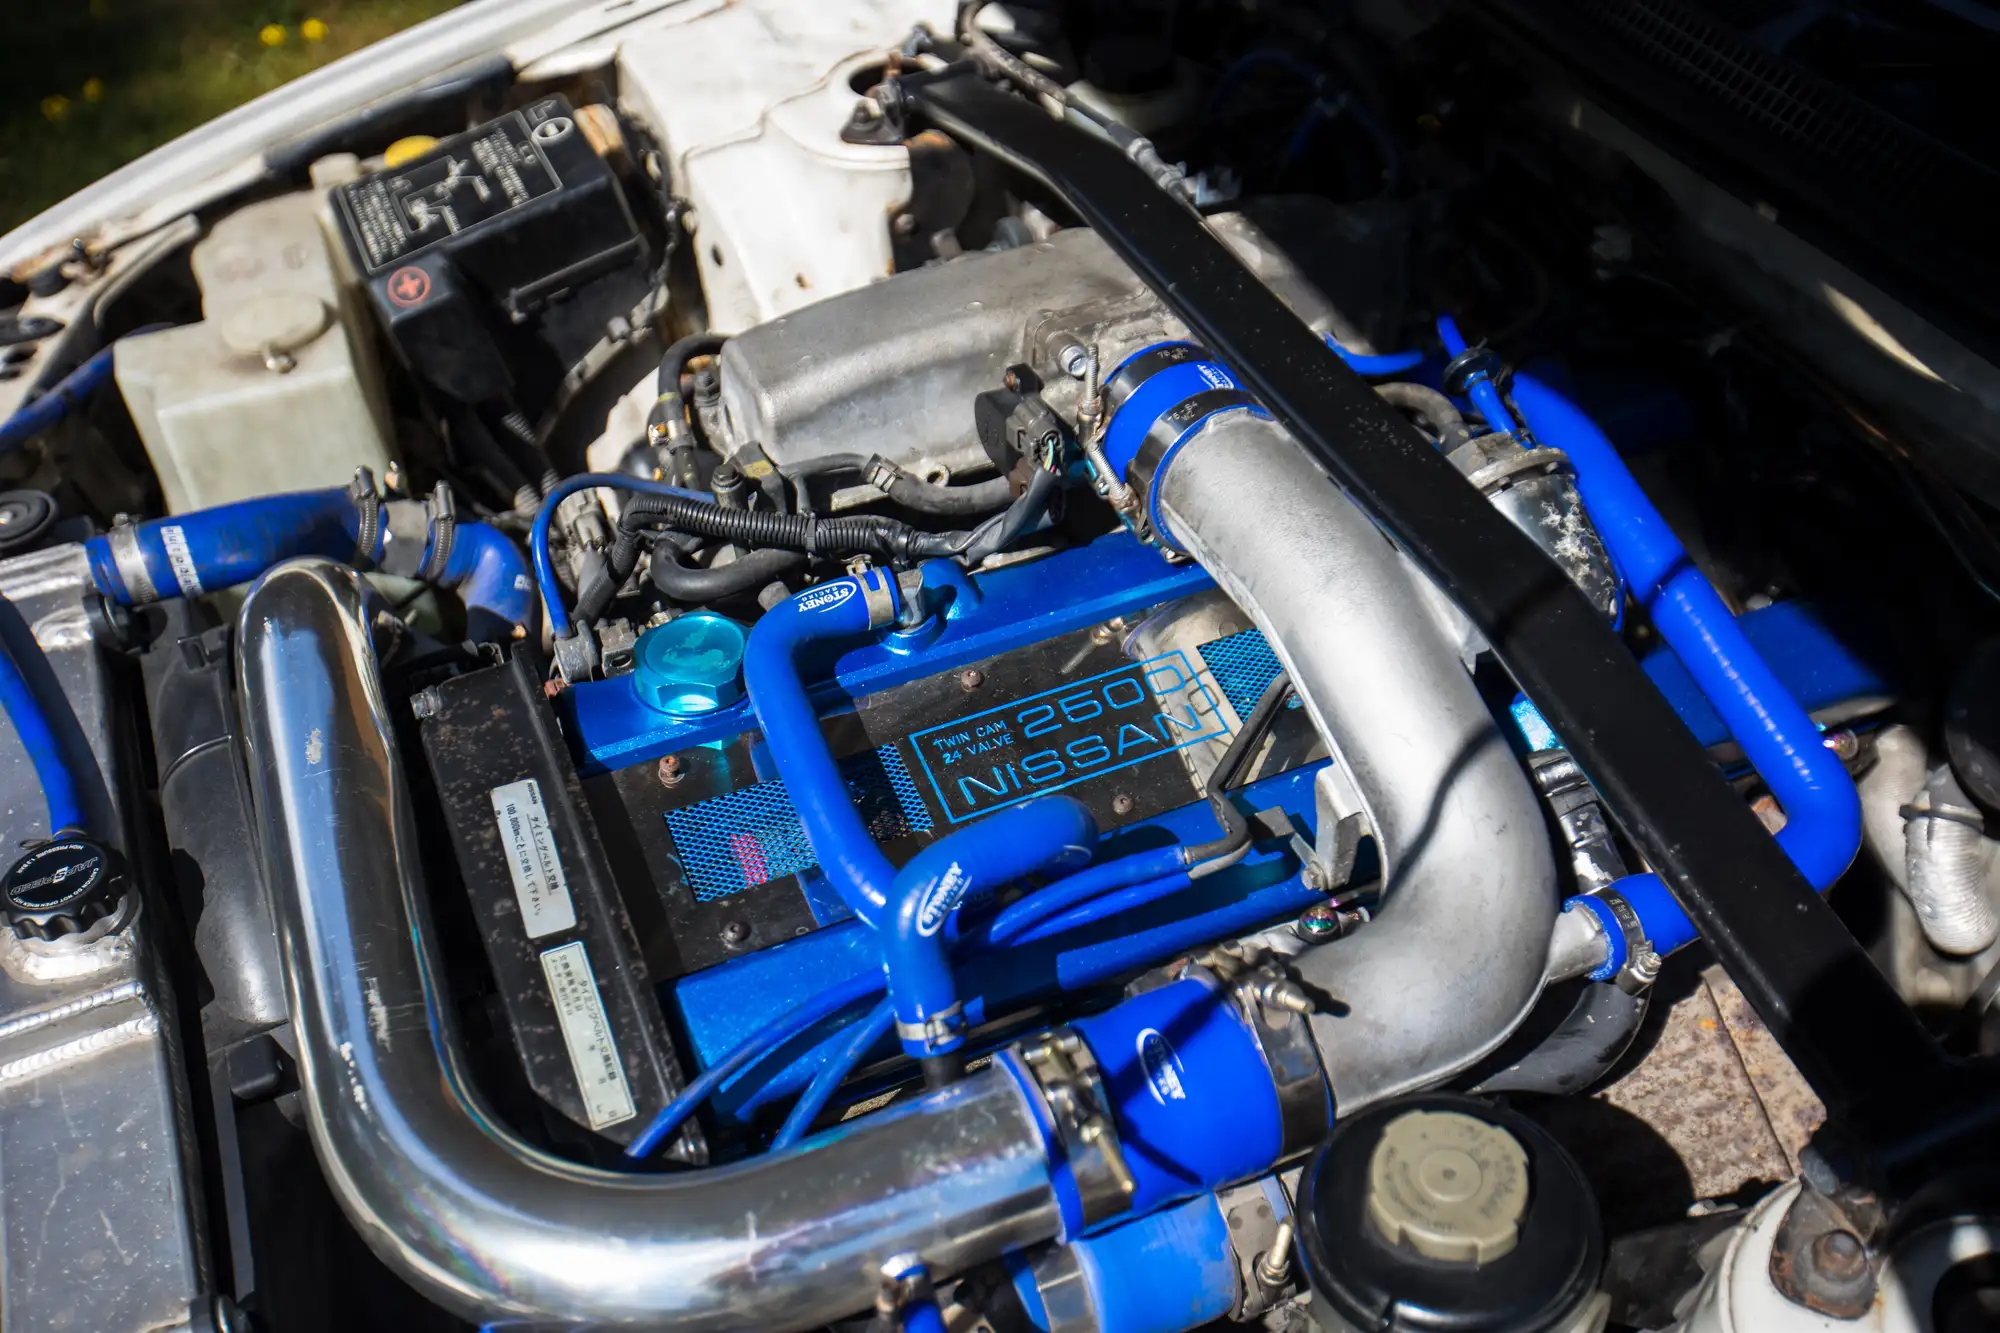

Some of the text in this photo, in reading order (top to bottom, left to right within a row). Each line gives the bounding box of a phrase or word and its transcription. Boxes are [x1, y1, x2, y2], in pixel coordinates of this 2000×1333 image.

[798, 588, 849, 612] STONEY
[801, 586, 838, 602] RACING
[932, 720, 1007, 751] TWIN CAM
[942, 733, 1014, 765] 24 VALVE
[958, 704, 1203, 805] NISSAN
[526, 782, 538, 805] NISSAN
[36, 844, 69, 858] PRESSURE
[81, 867, 99, 889] CAUTION
[60, 894, 73, 902] NOT
[73, 887, 83, 895] DO
